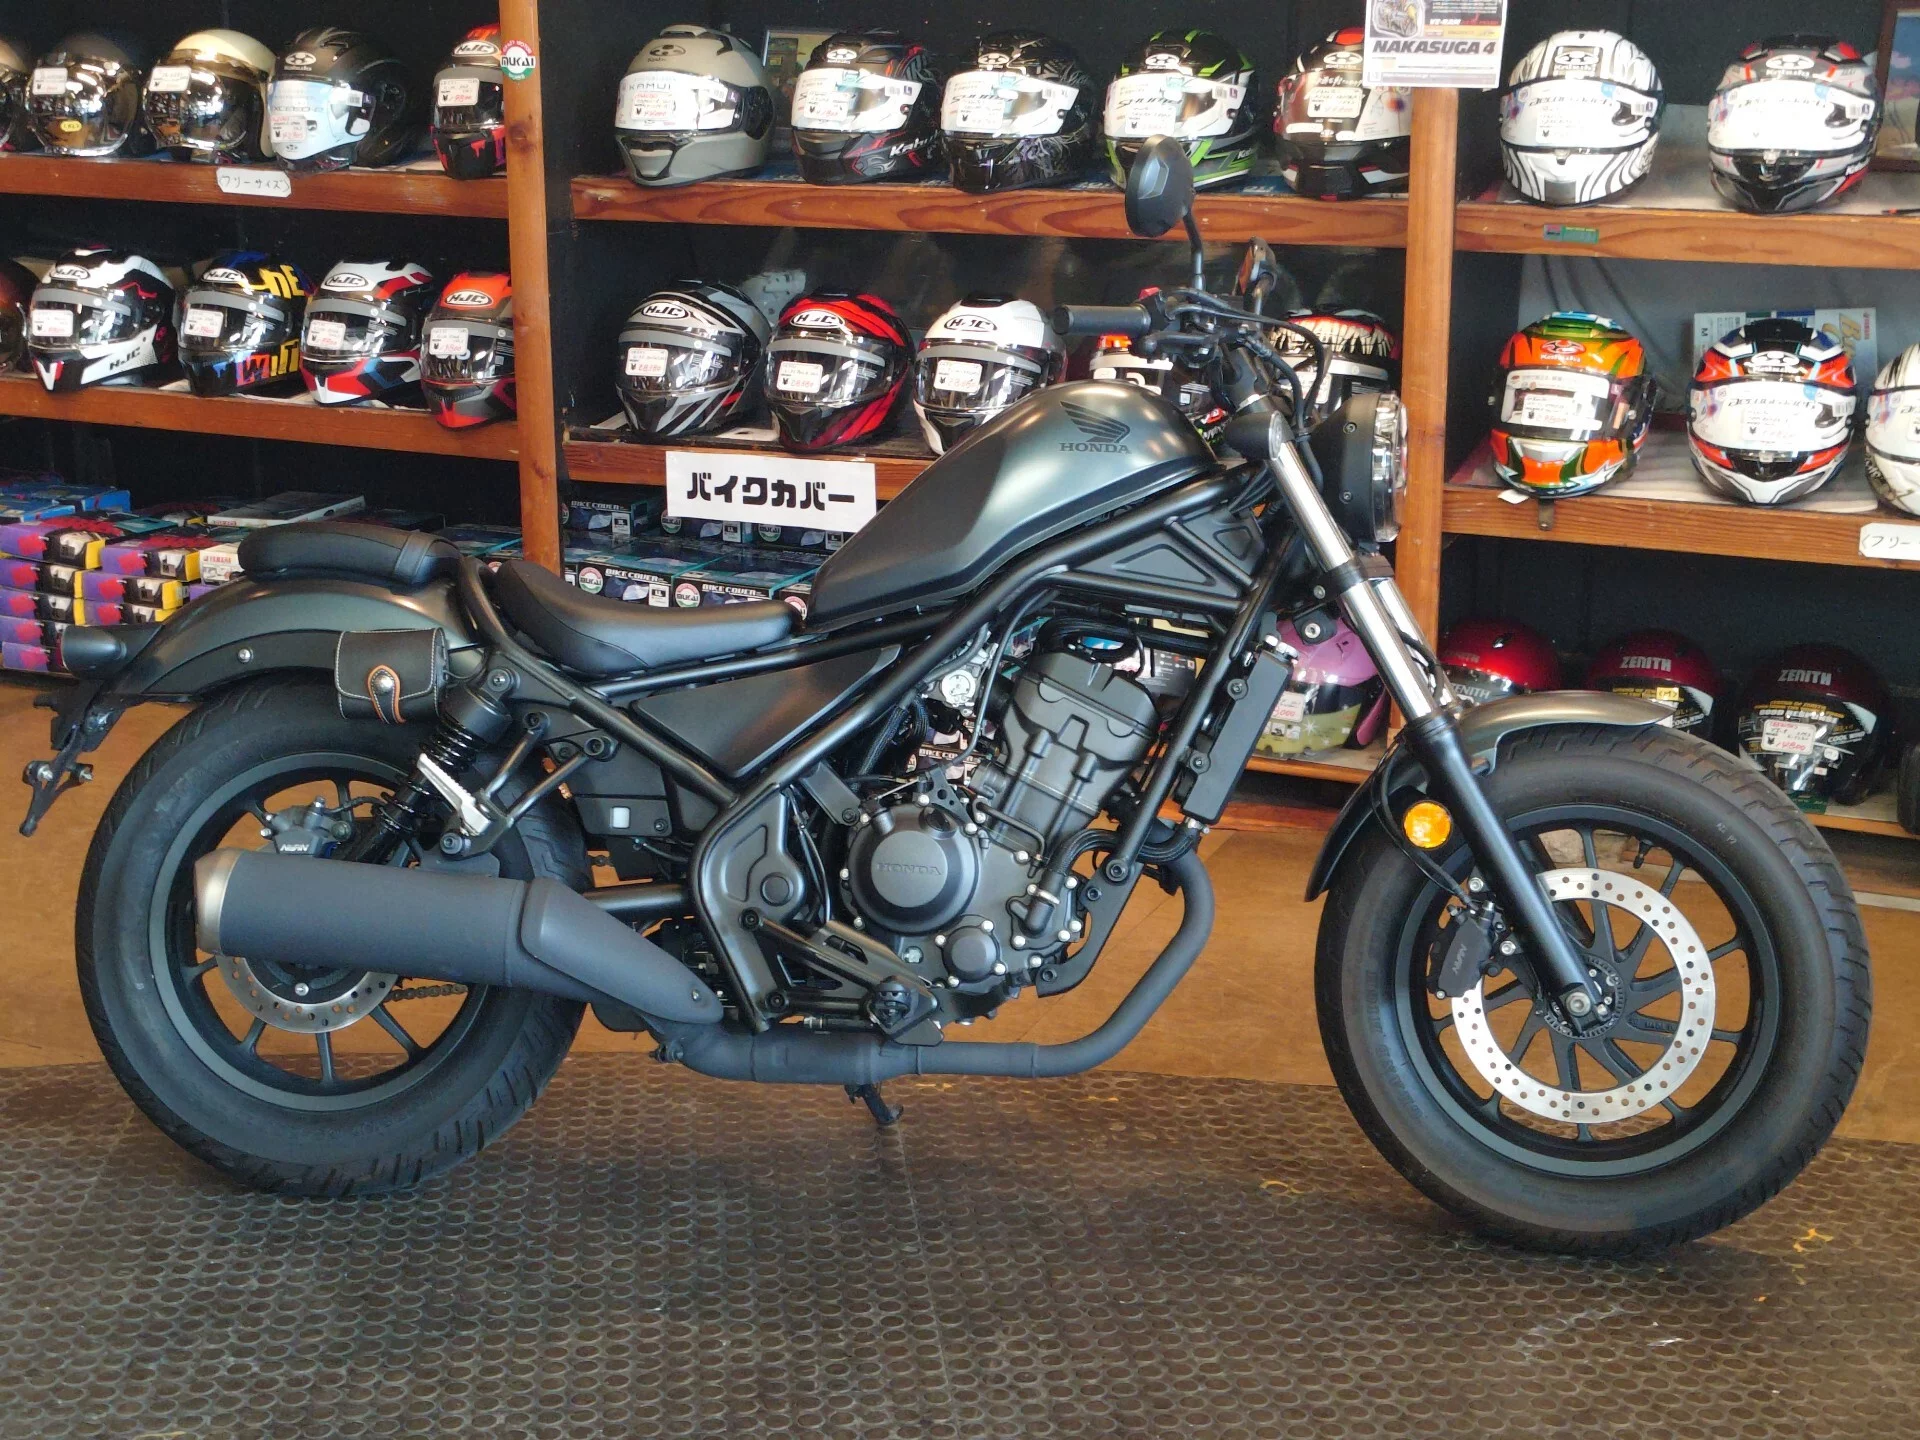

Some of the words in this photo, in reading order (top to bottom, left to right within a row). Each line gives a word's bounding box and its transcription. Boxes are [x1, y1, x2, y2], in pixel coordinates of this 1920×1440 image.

[1372, 40, 1480, 54] NAKASUGA
[1483, 42, 1496, 54] 4
[501, 56, 534, 67] MUKAI
[329, 276, 362, 285] HJC
[449, 294, 486, 303] HJC
[645, 305, 682, 317] HJC
[797, 314, 837, 324] HJC
[949, 318, 991, 329] HJC
[1059, 442, 1132, 455] HONDA
[687, 472, 855, 511] バイクカバー
[605, 568, 628, 577] BIKE
[628, 571, 658, 582] COVER
[702, 583, 725, 593] BIKE
[725, 586, 757, 596] COVER
[1619, 655, 1672, 672] ZENITH
[1777, 669, 1832, 686] ZENITH
[876, 862, 942, 876] HONDA
